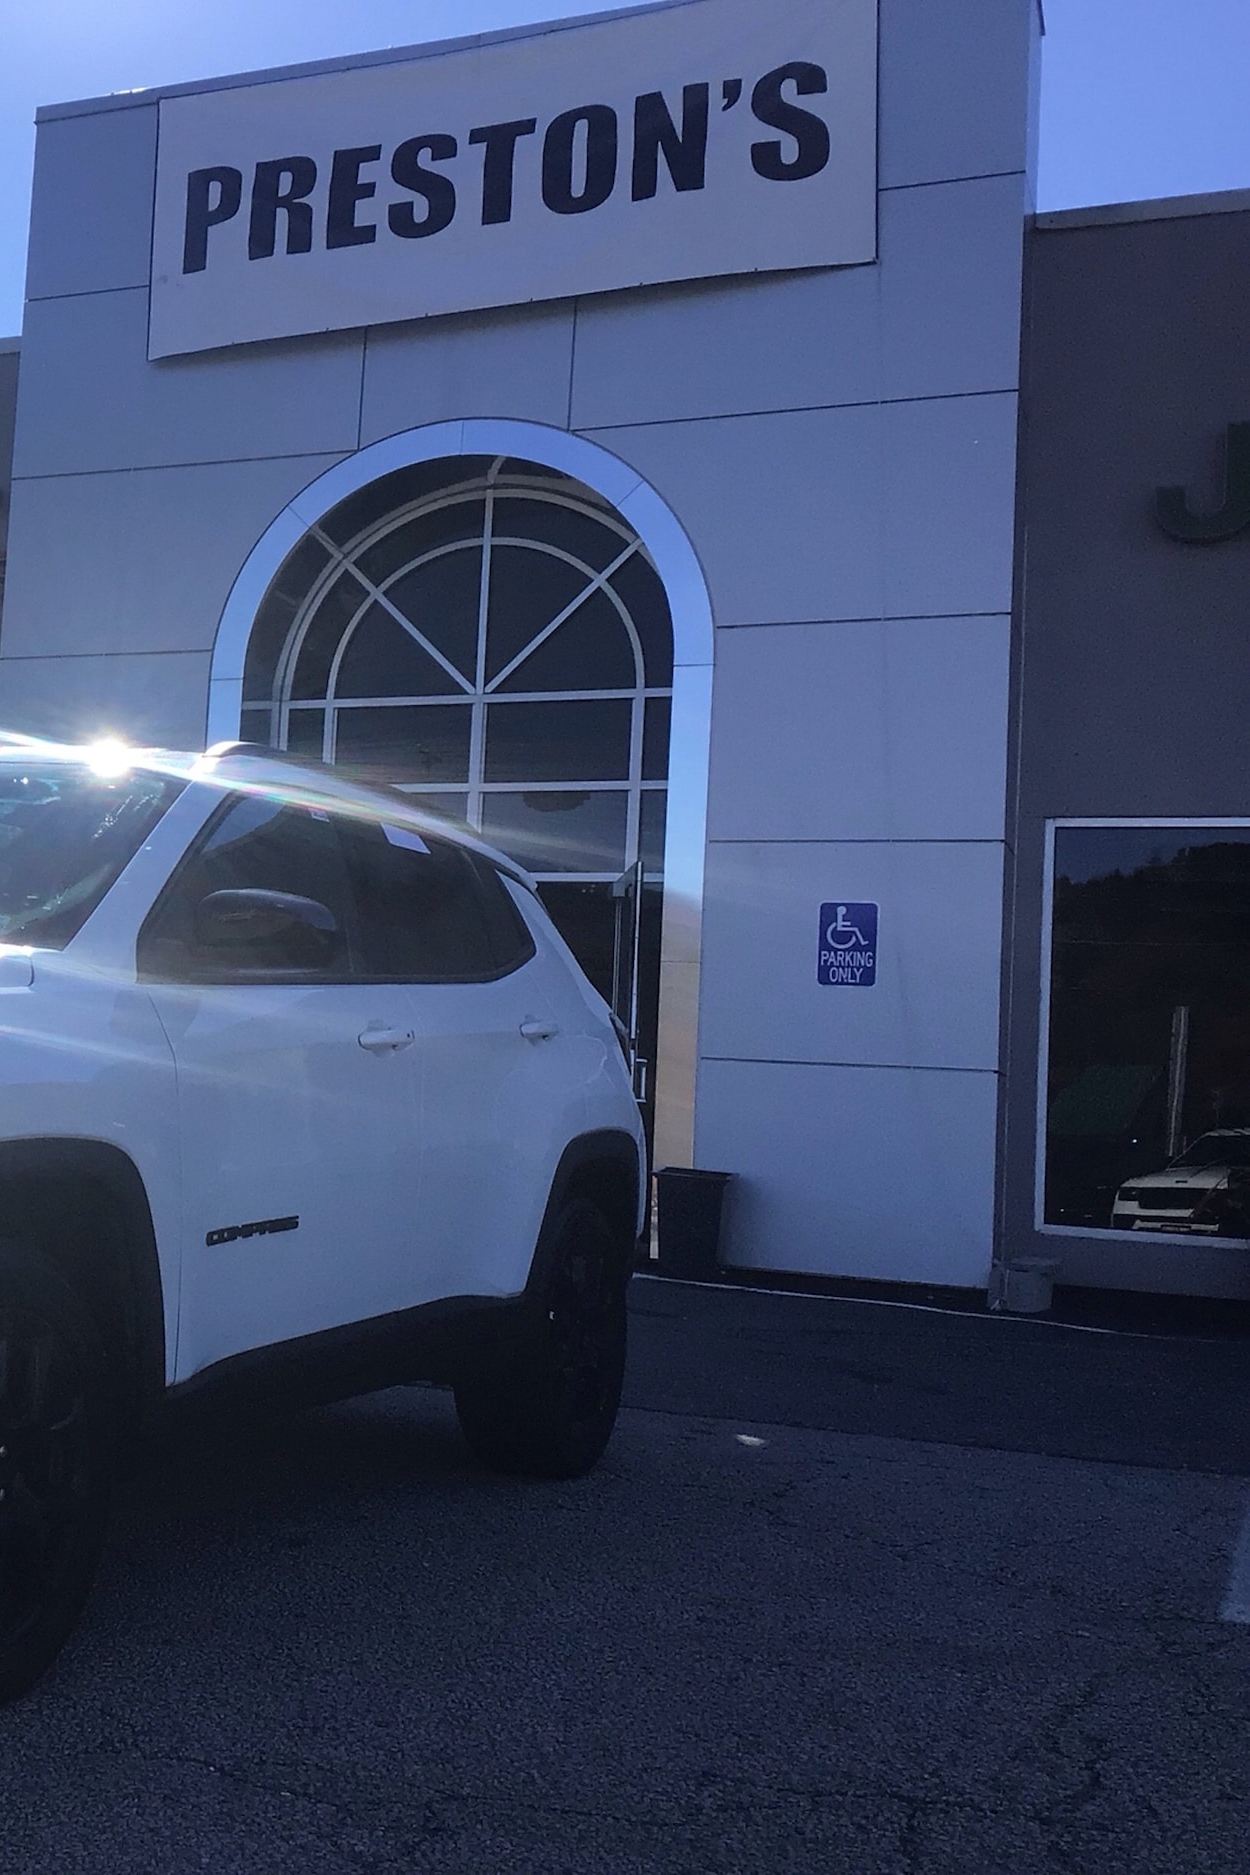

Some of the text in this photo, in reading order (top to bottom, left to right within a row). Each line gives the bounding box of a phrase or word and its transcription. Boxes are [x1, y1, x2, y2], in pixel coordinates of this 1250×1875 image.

[182, 61, 830, 274] PRESTON'S
[820, 950, 874, 967] PARKING
[829, 966, 864, 983] ONLY
